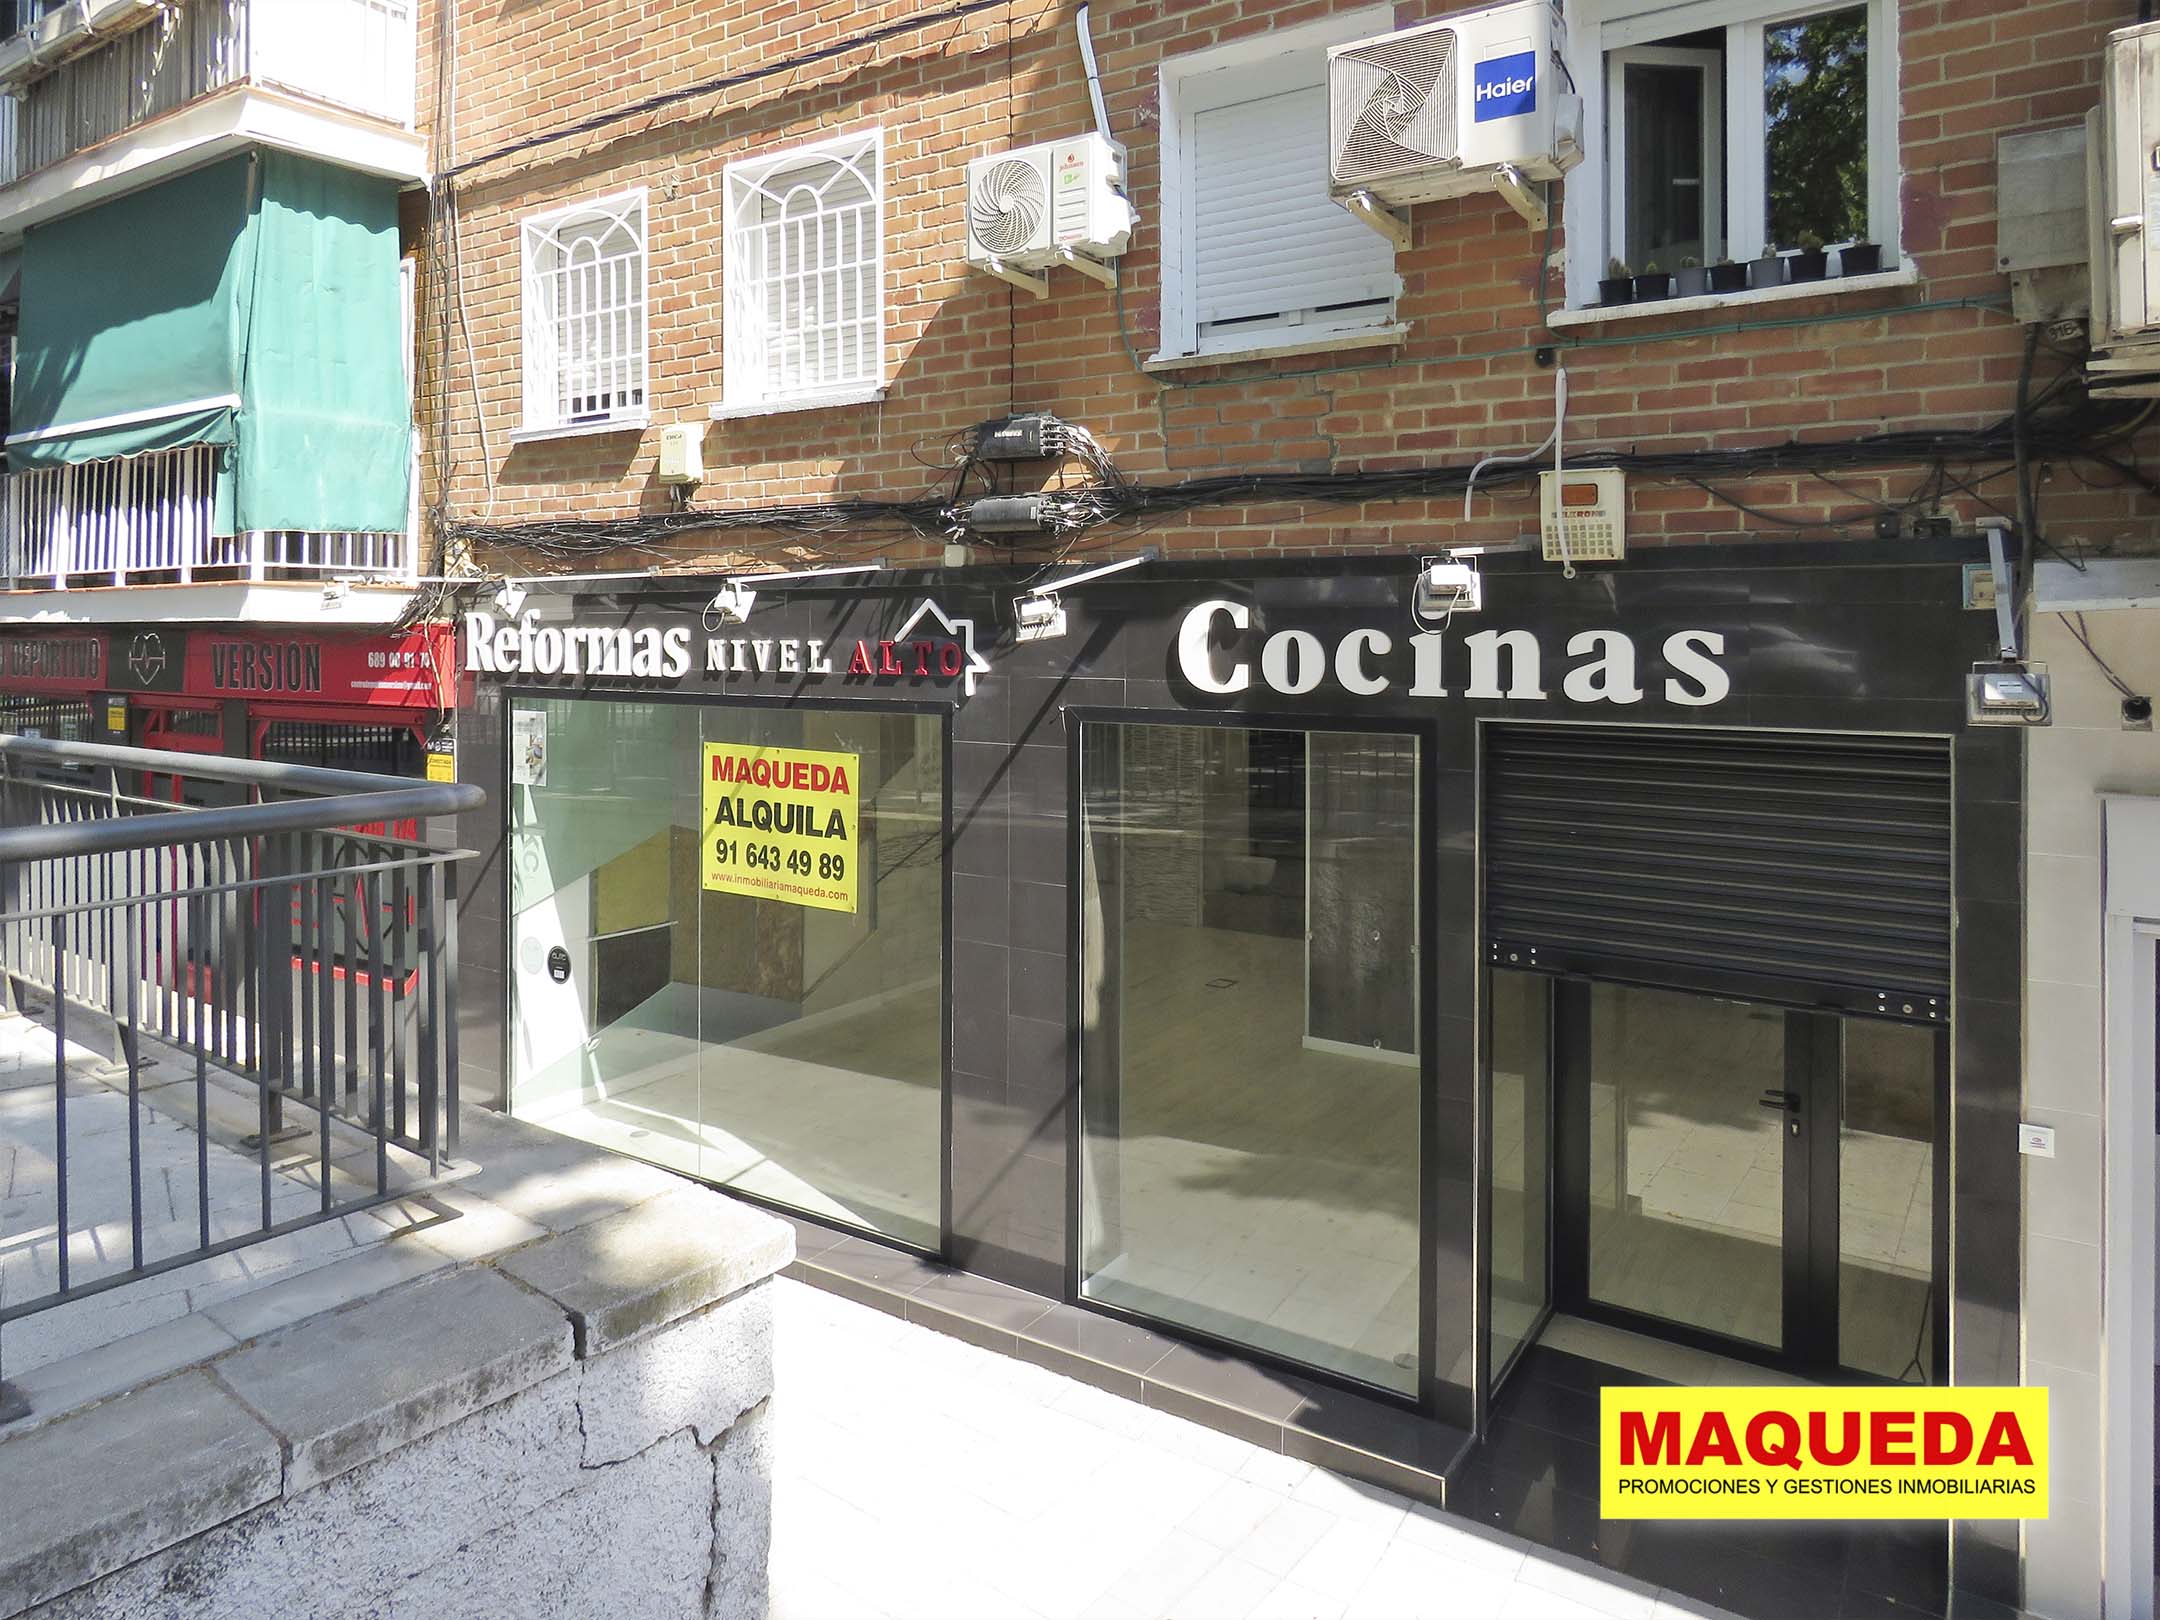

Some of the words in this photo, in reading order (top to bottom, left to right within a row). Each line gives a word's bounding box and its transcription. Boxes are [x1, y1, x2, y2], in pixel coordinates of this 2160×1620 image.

[1476, 76, 1534, 102] Haier
[368, 652, 385, 668] 689
[464, 609, 692, 678] Reformas
[706, 639, 832, 674] NIVEL
[849, 640, 963, 676] ALTO
[1178, 600, 1731, 706] Cocinas
[211, 641, 321, 692] VERSION
[711, 755, 850, 795] MAQUEDA
[714, 796, 848, 841] ALQUILA
[716, 838, 737, 865] 91
[746, 842, 781, 872] 643
[787, 849, 812, 877] 49
[818, 852, 845, 881] 89
[711, 871, 848, 901] www.inmobiliariamaqueda.com
